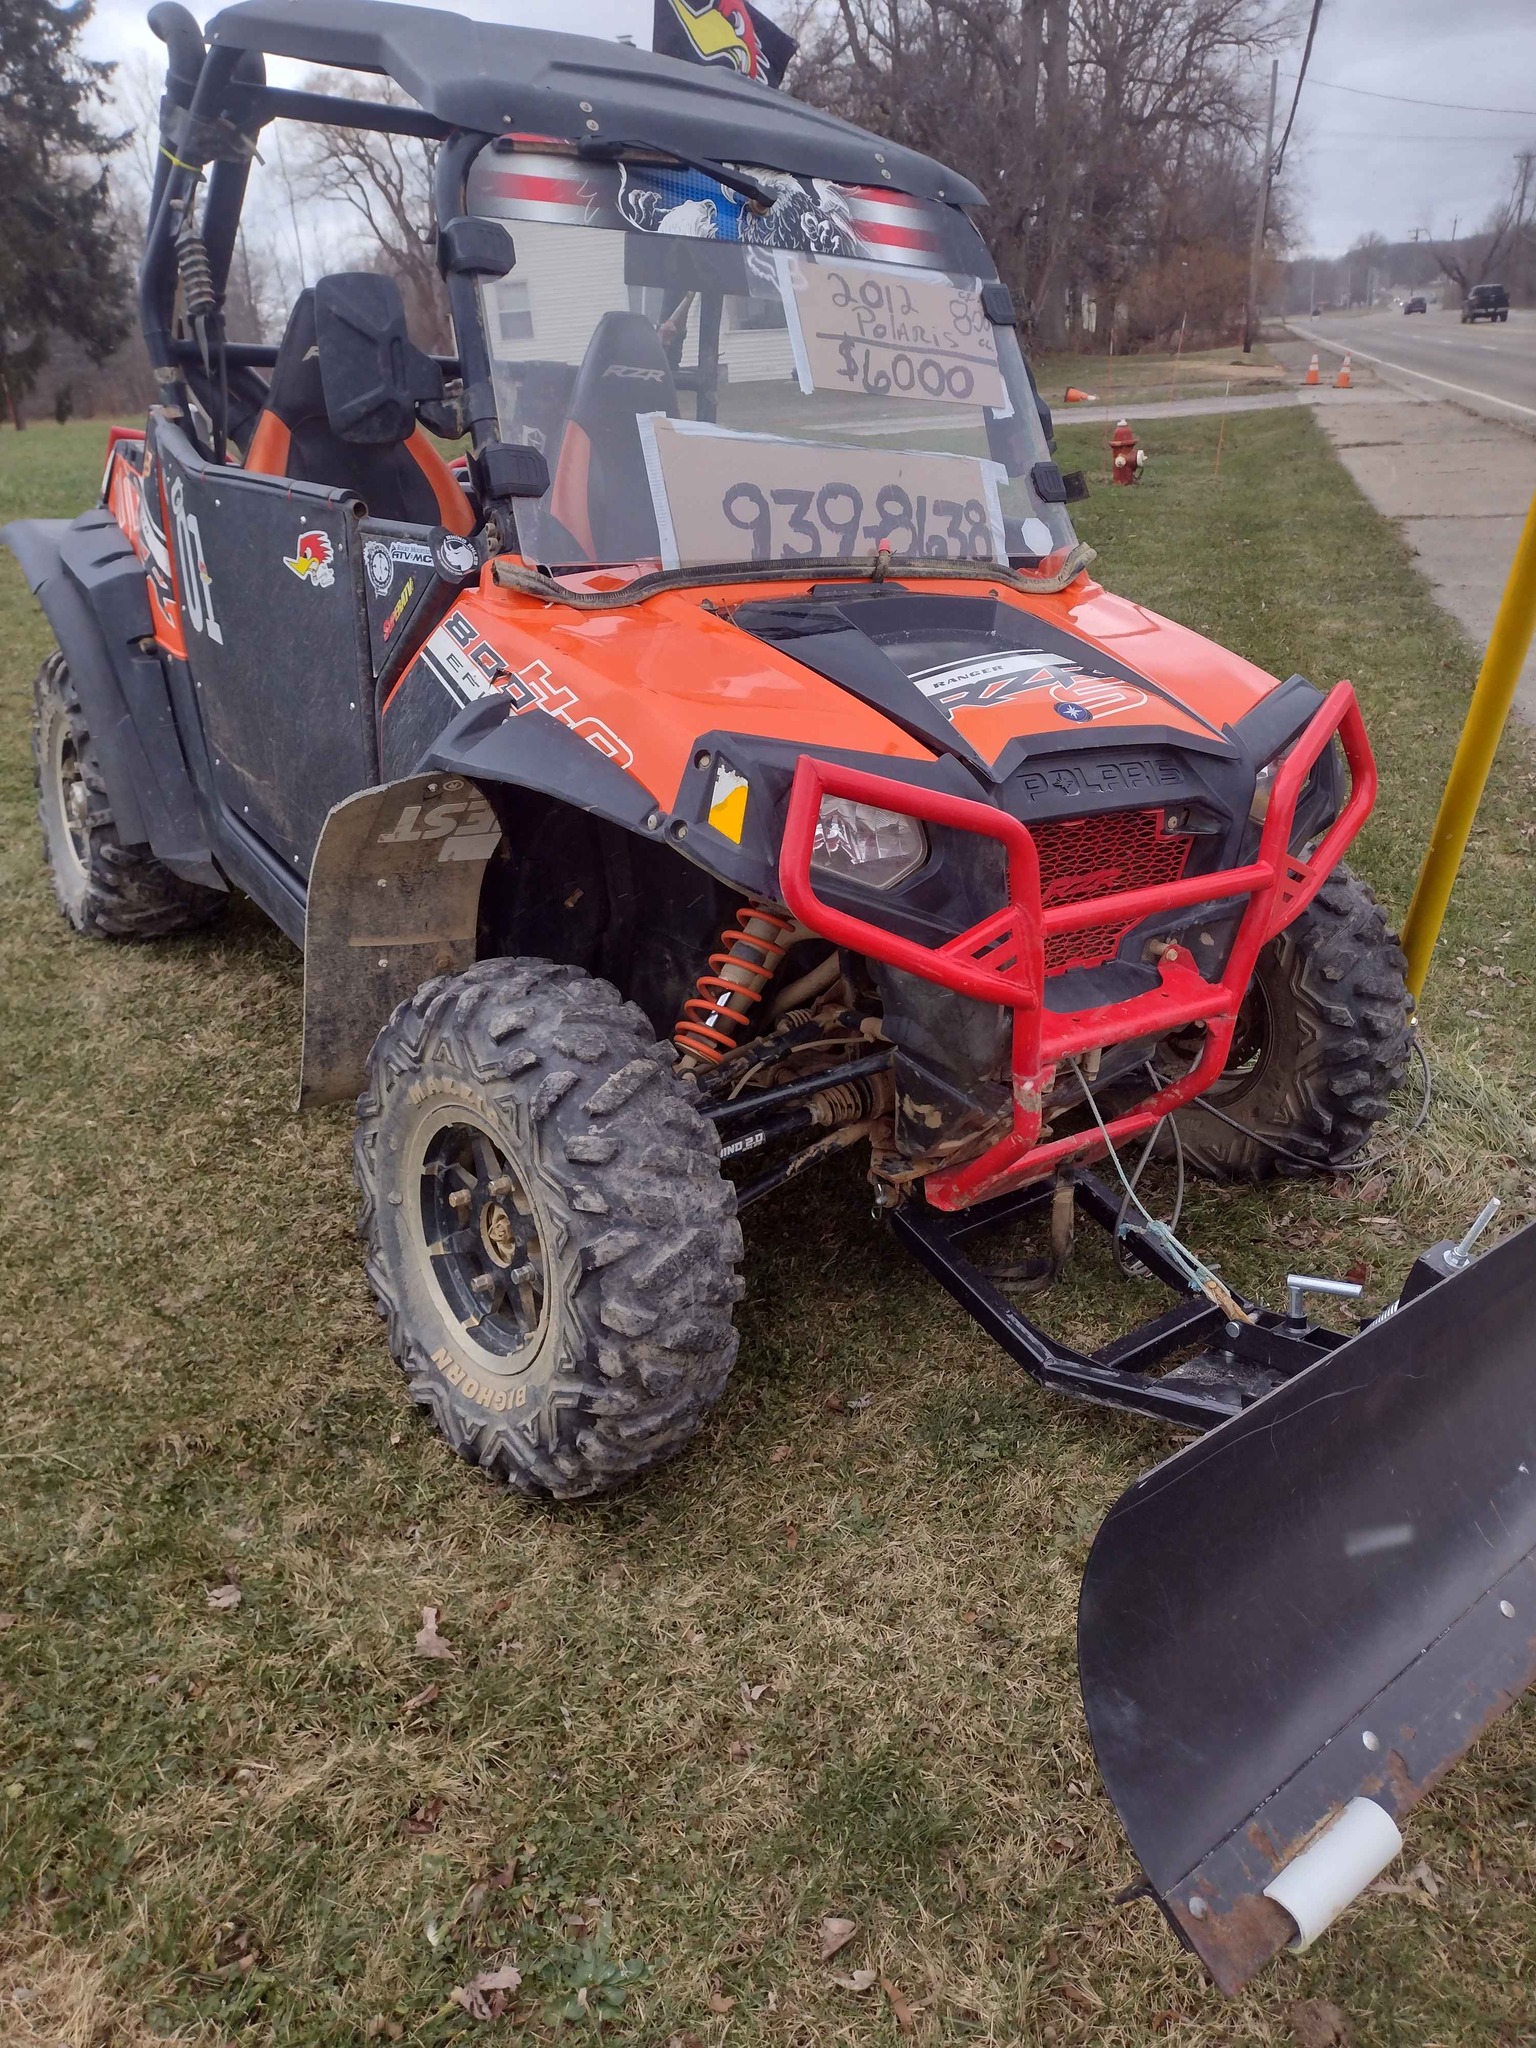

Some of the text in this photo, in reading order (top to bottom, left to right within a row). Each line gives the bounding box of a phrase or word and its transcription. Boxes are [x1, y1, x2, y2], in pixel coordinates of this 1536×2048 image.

[827, 273, 919, 316] 2012
[602, 365, 665, 383] RZR
[836, 332, 974, 399] $6000
[932, 664, 1004, 689] RANGER
[1016, 758, 1185, 802] POLARIS
[431, 1347, 527, 1413] BIGHORN
